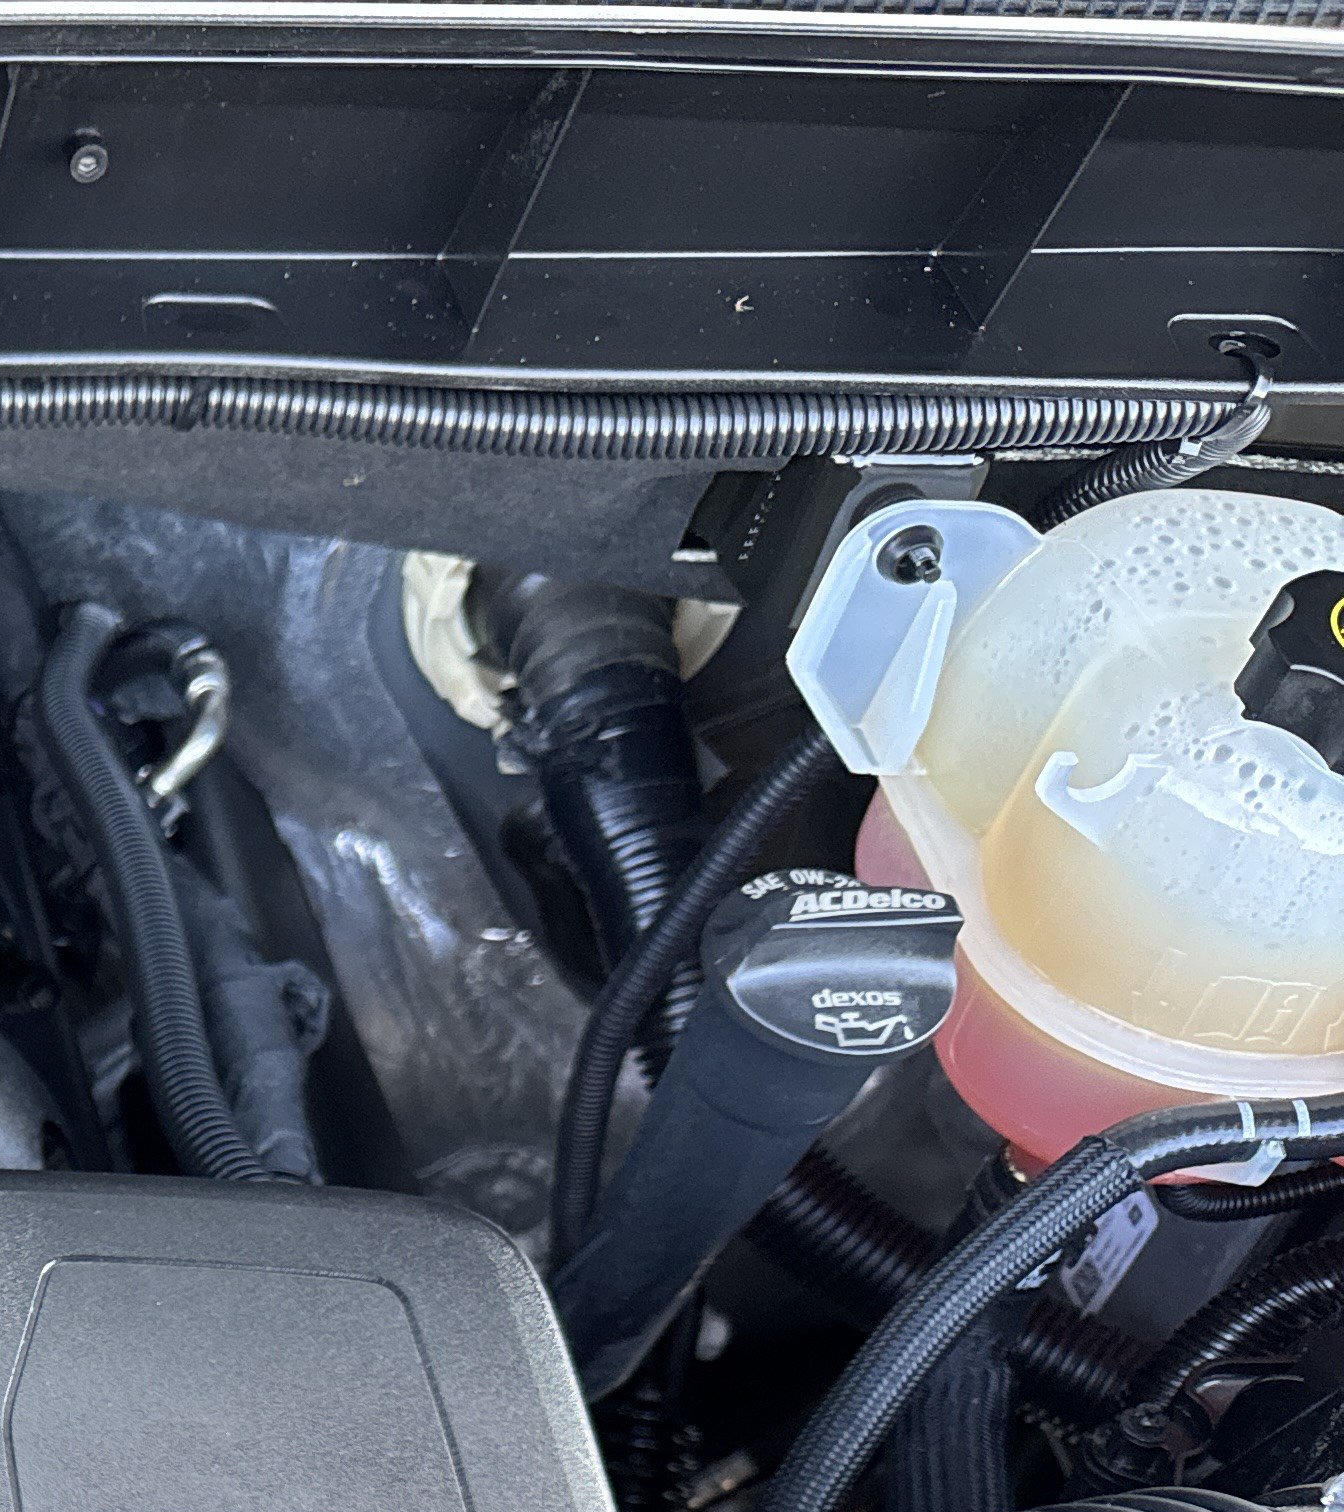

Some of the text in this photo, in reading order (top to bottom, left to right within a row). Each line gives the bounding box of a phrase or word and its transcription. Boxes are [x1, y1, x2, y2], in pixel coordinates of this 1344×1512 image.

[740, 872, 787, 900] SAE
[789, 888, 946, 915] ACDelco
[811, 987, 902, 1009] dexos
